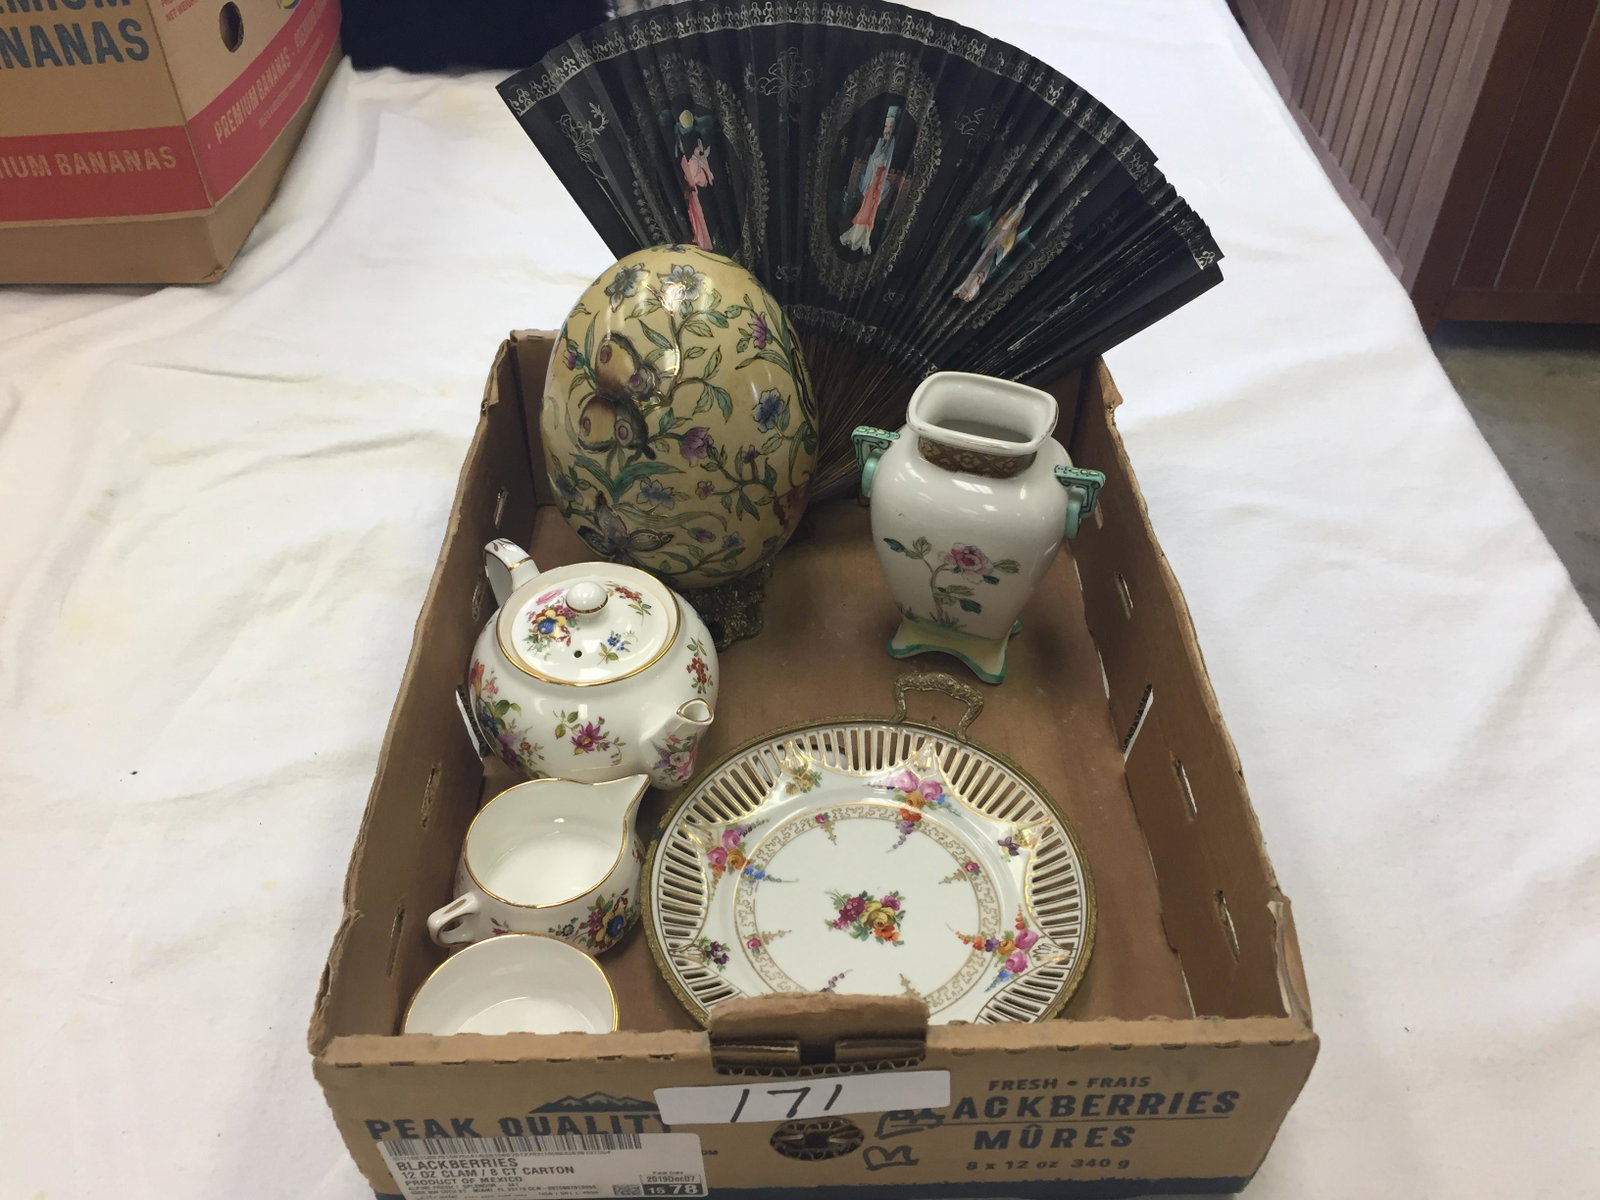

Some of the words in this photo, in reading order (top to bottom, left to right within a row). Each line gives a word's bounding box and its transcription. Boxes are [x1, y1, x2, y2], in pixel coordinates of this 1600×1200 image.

[0, 18, 149, 69] NANAS
[213, 85, 260, 144] PREMIUM
[256, 47, 291, 101] BANANAS
[0, 154, 52, 179] IUM
[54, 146, 177, 176] BANANAS
[988, 1077, 1058, 1091] FRESH
[1087, 1076, 1152, 1089] FRAIS
[730, 1084, 842, 1123] 171
[364, 1118, 481, 1139] PEAK
[974, 1124, 1136, 1150] MÛRES
[396, 1158, 518, 1171] BLACKBERRIES
[402, 1171, 416, 1180] 12
[420, 1169, 436, 1179] OZ
[442, 1168, 477, 1178] CLAM
[502, 1167, 516, 1176] CT
[522, 1166, 575, 1176] CARTON
[966, 1160, 978, 1170] 8
[985, 1162, 997, 1170] x
[1005, 1159, 1029, 1170] 12
[1036, 1160, 1058, 1169] oz
[1071, 1158, 1111, 1169] 340
[1117, 1160, 1130, 1170] g
[405, 1178, 456, 1186] PRODUCT
[669, 1184, 698, 1194] 78
